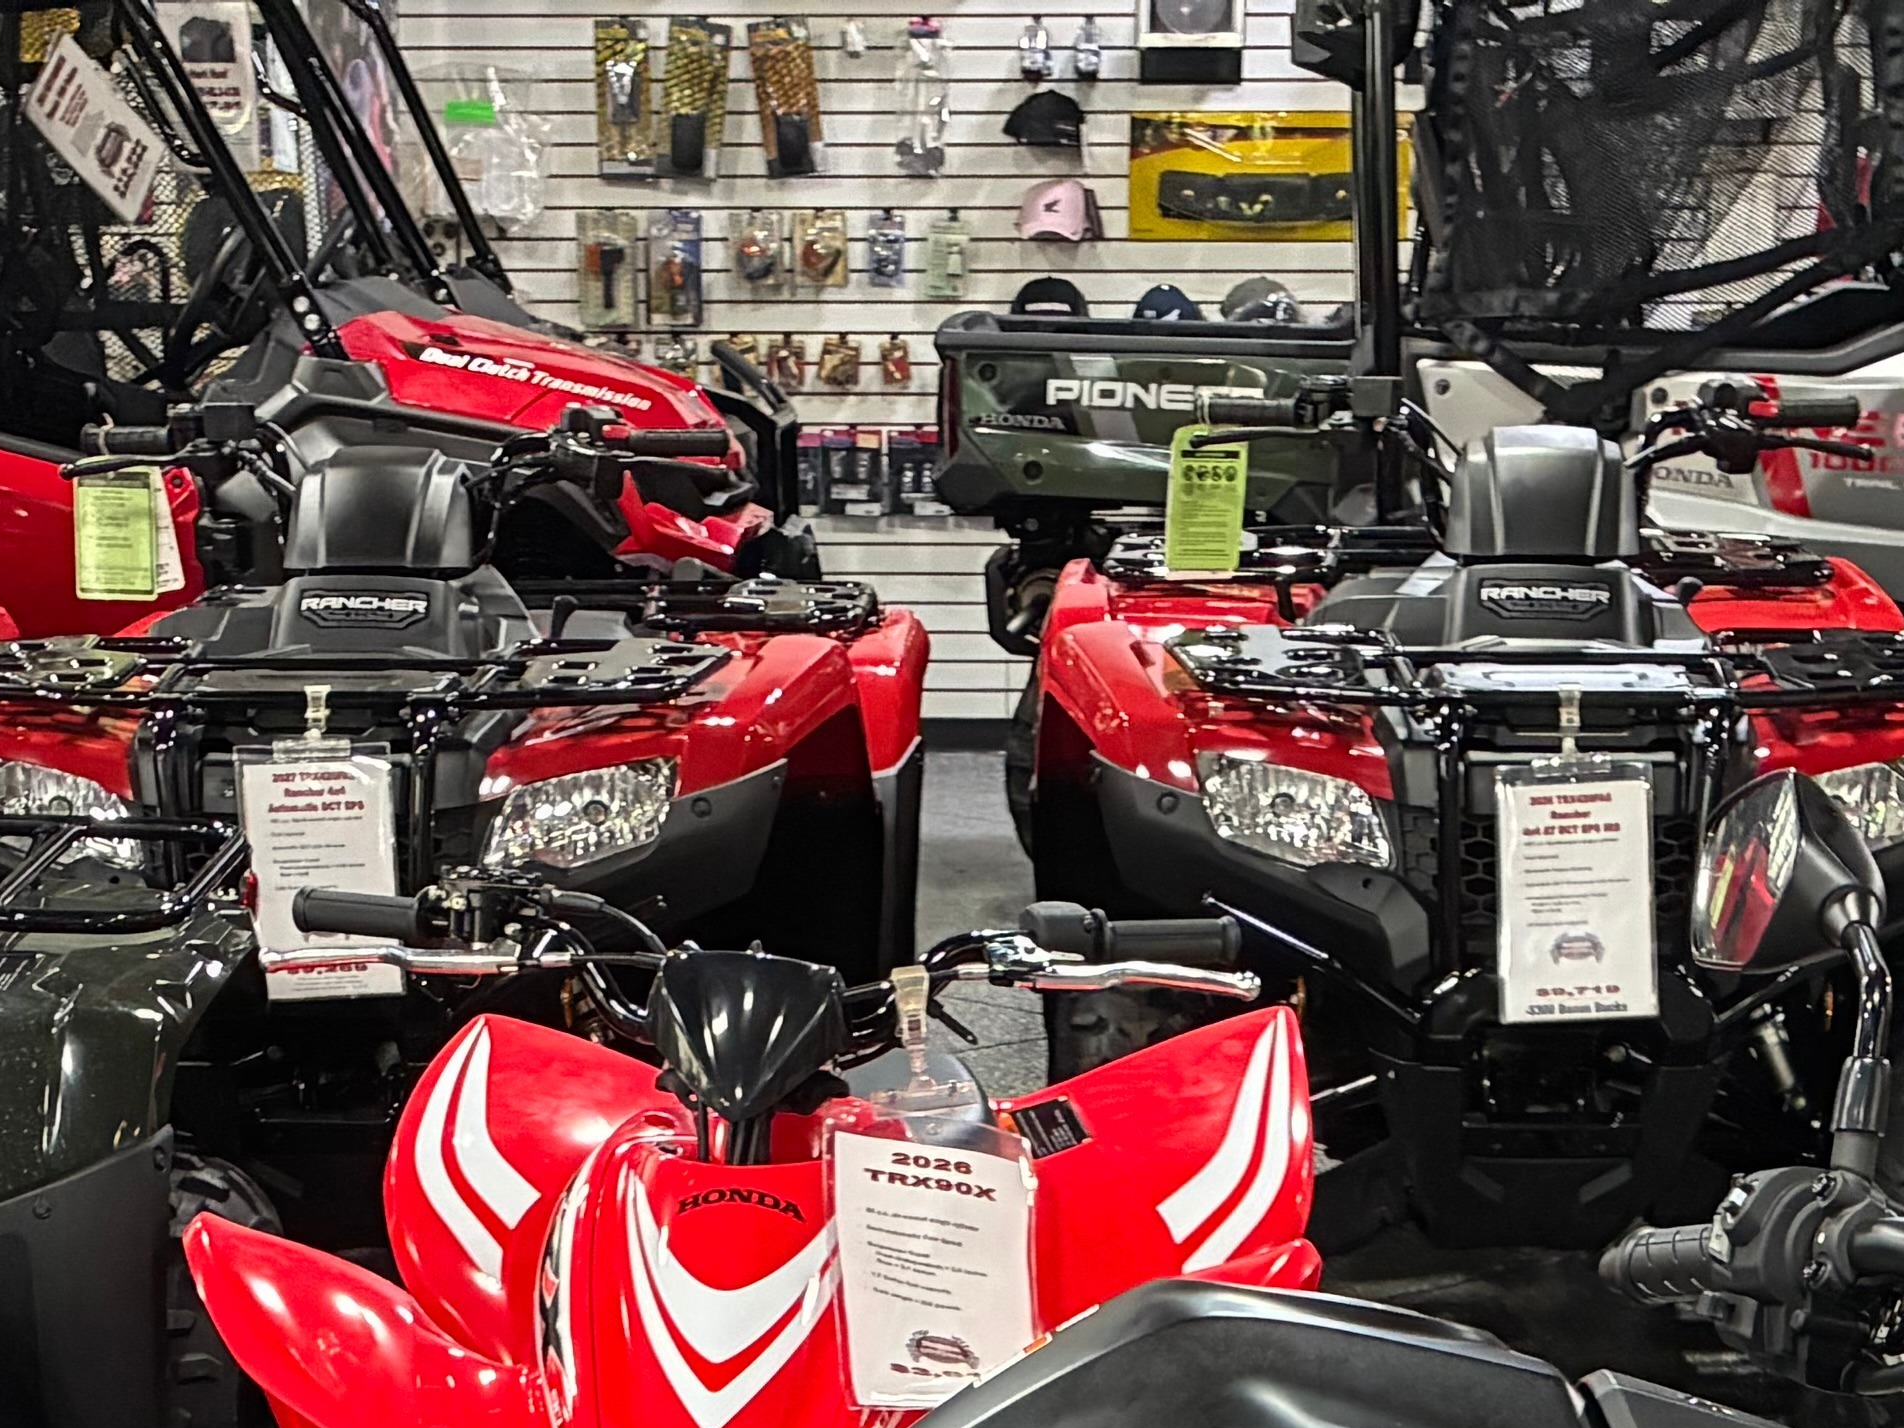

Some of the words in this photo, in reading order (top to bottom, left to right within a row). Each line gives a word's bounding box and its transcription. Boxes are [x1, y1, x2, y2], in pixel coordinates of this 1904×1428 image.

[419, 347, 470, 369] Dual
[467, 357, 531, 382] Clutch
[529, 370, 652, 411] Transmission
[1046, 378, 1264, 411] PIONE
[979, 412, 1066, 430] HONDA
[1653, 464, 1734, 489] ONDA
[300, 595, 428, 614] RANCHER
[1480, 586, 1611, 604] RANCHER
[891, 1152, 973, 1176] 2026
[863, 1167, 998, 1203] TRX90X
[674, 1187, 807, 1225] HONDA
